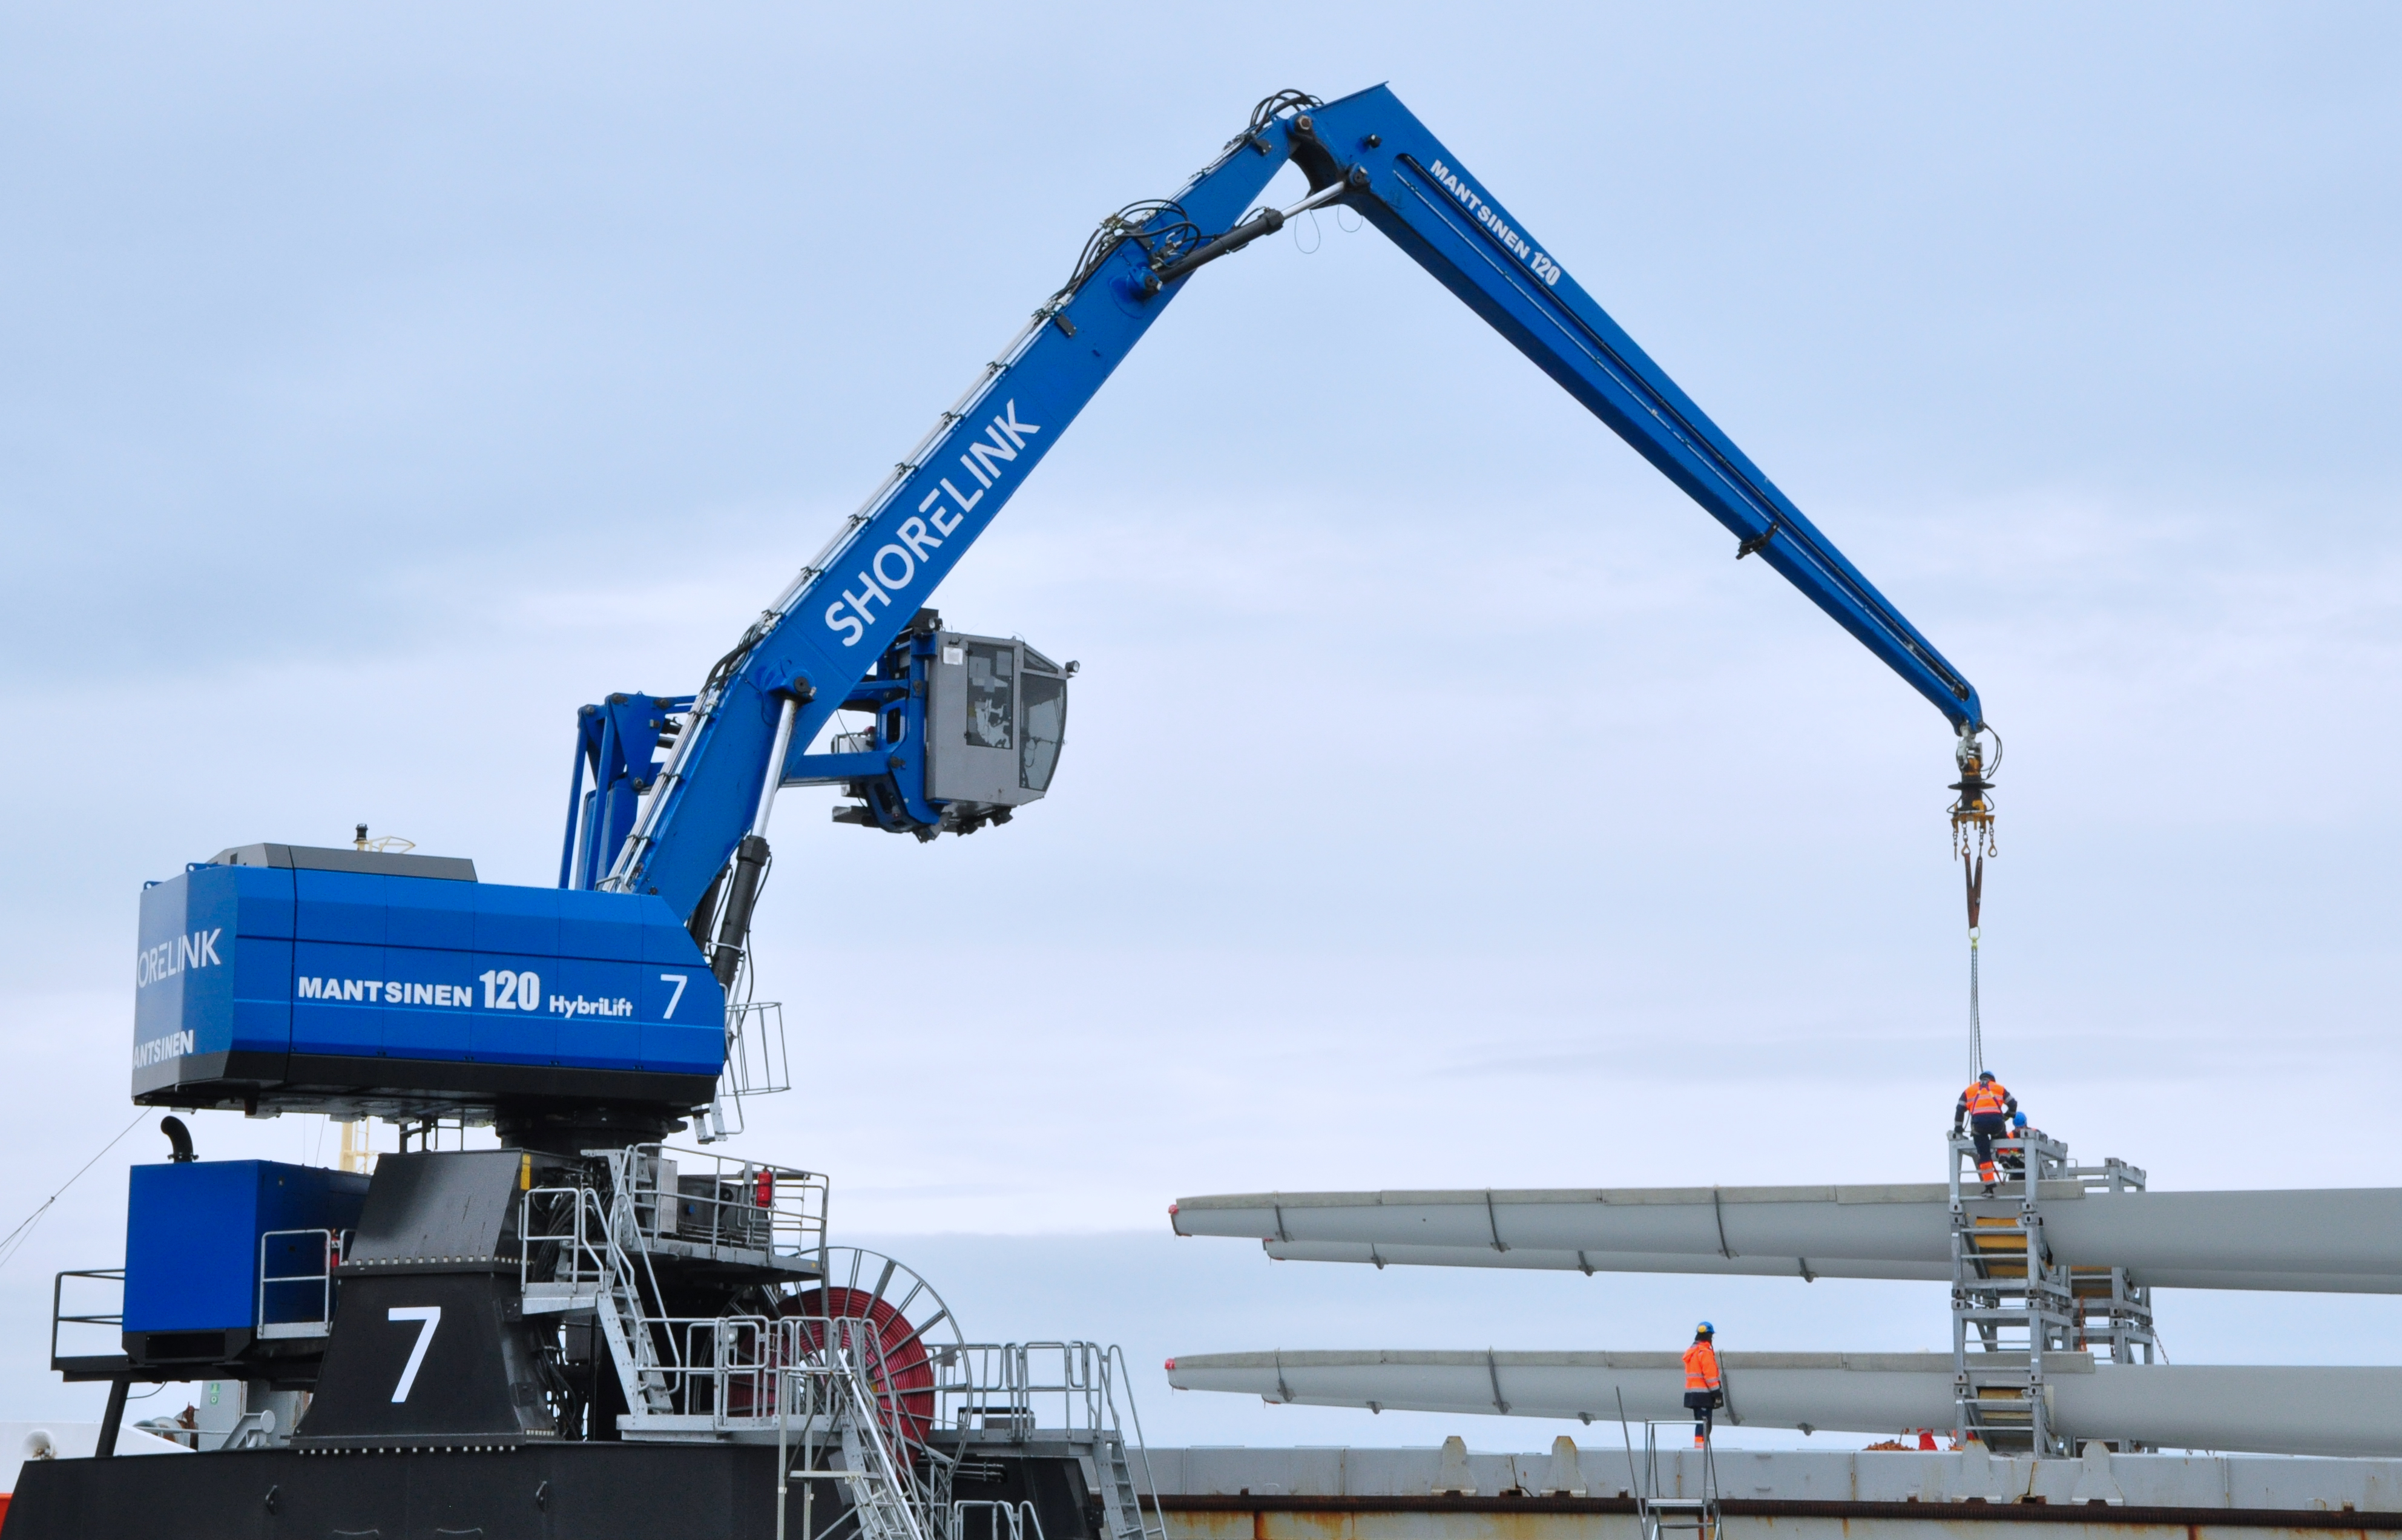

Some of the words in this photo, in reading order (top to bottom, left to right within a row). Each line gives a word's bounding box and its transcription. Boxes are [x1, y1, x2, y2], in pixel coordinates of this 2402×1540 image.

[1430, 159, 1530, 260] MANTSINEN
[1530, 251, 1561, 286] 120
[824, 398, 1041, 647] SHORELINK
[298, 976, 473, 1007] MANTSINEN
[479, 970, 540, 1011] 120
[549, 995, 633, 1019] HybriLift
[660, 973, 688, 1019] 7
[388, 1306, 441, 1403] 7
